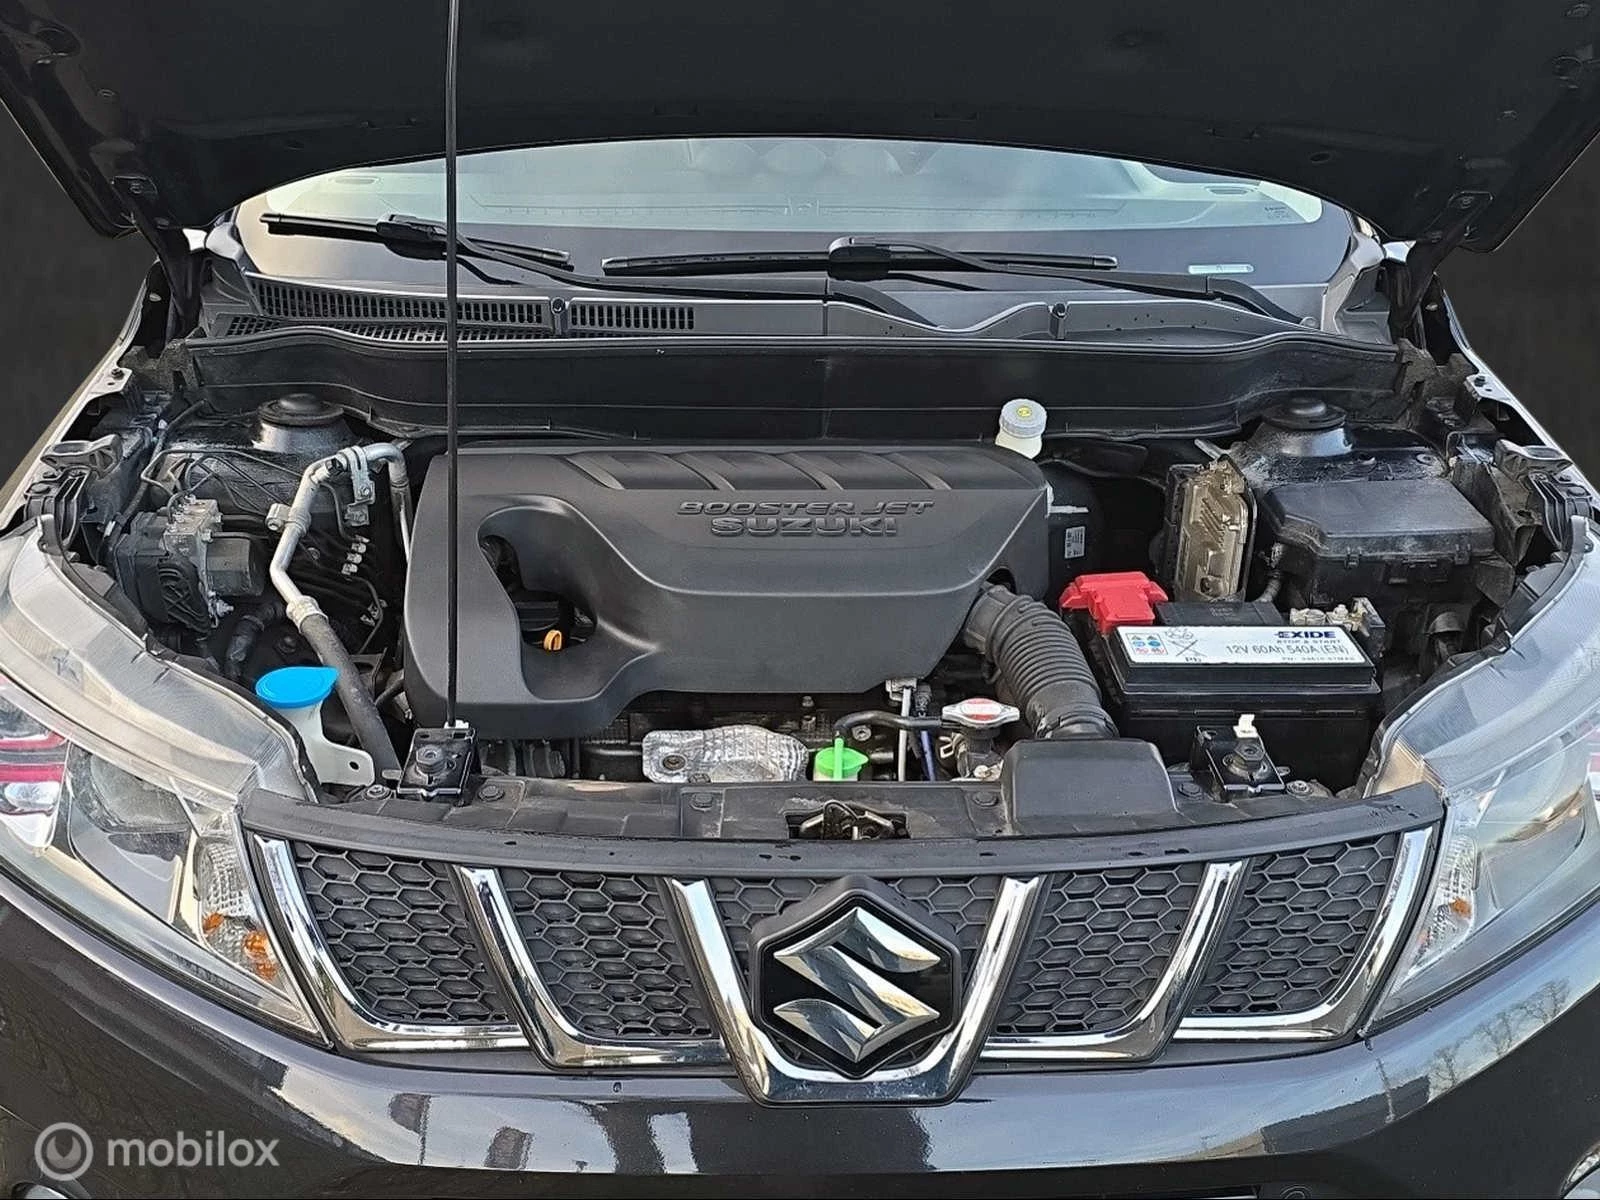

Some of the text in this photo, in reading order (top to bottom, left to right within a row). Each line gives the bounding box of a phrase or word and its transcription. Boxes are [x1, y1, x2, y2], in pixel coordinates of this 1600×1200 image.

[677, 501, 935, 516] BOOSTER JET
[711, 517, 898, 538] SUZUKI
[1277, 630, 1337, 639] EXIDE
[1225, 644, 1350, 656] 12V 60Ah 540A (EN)
